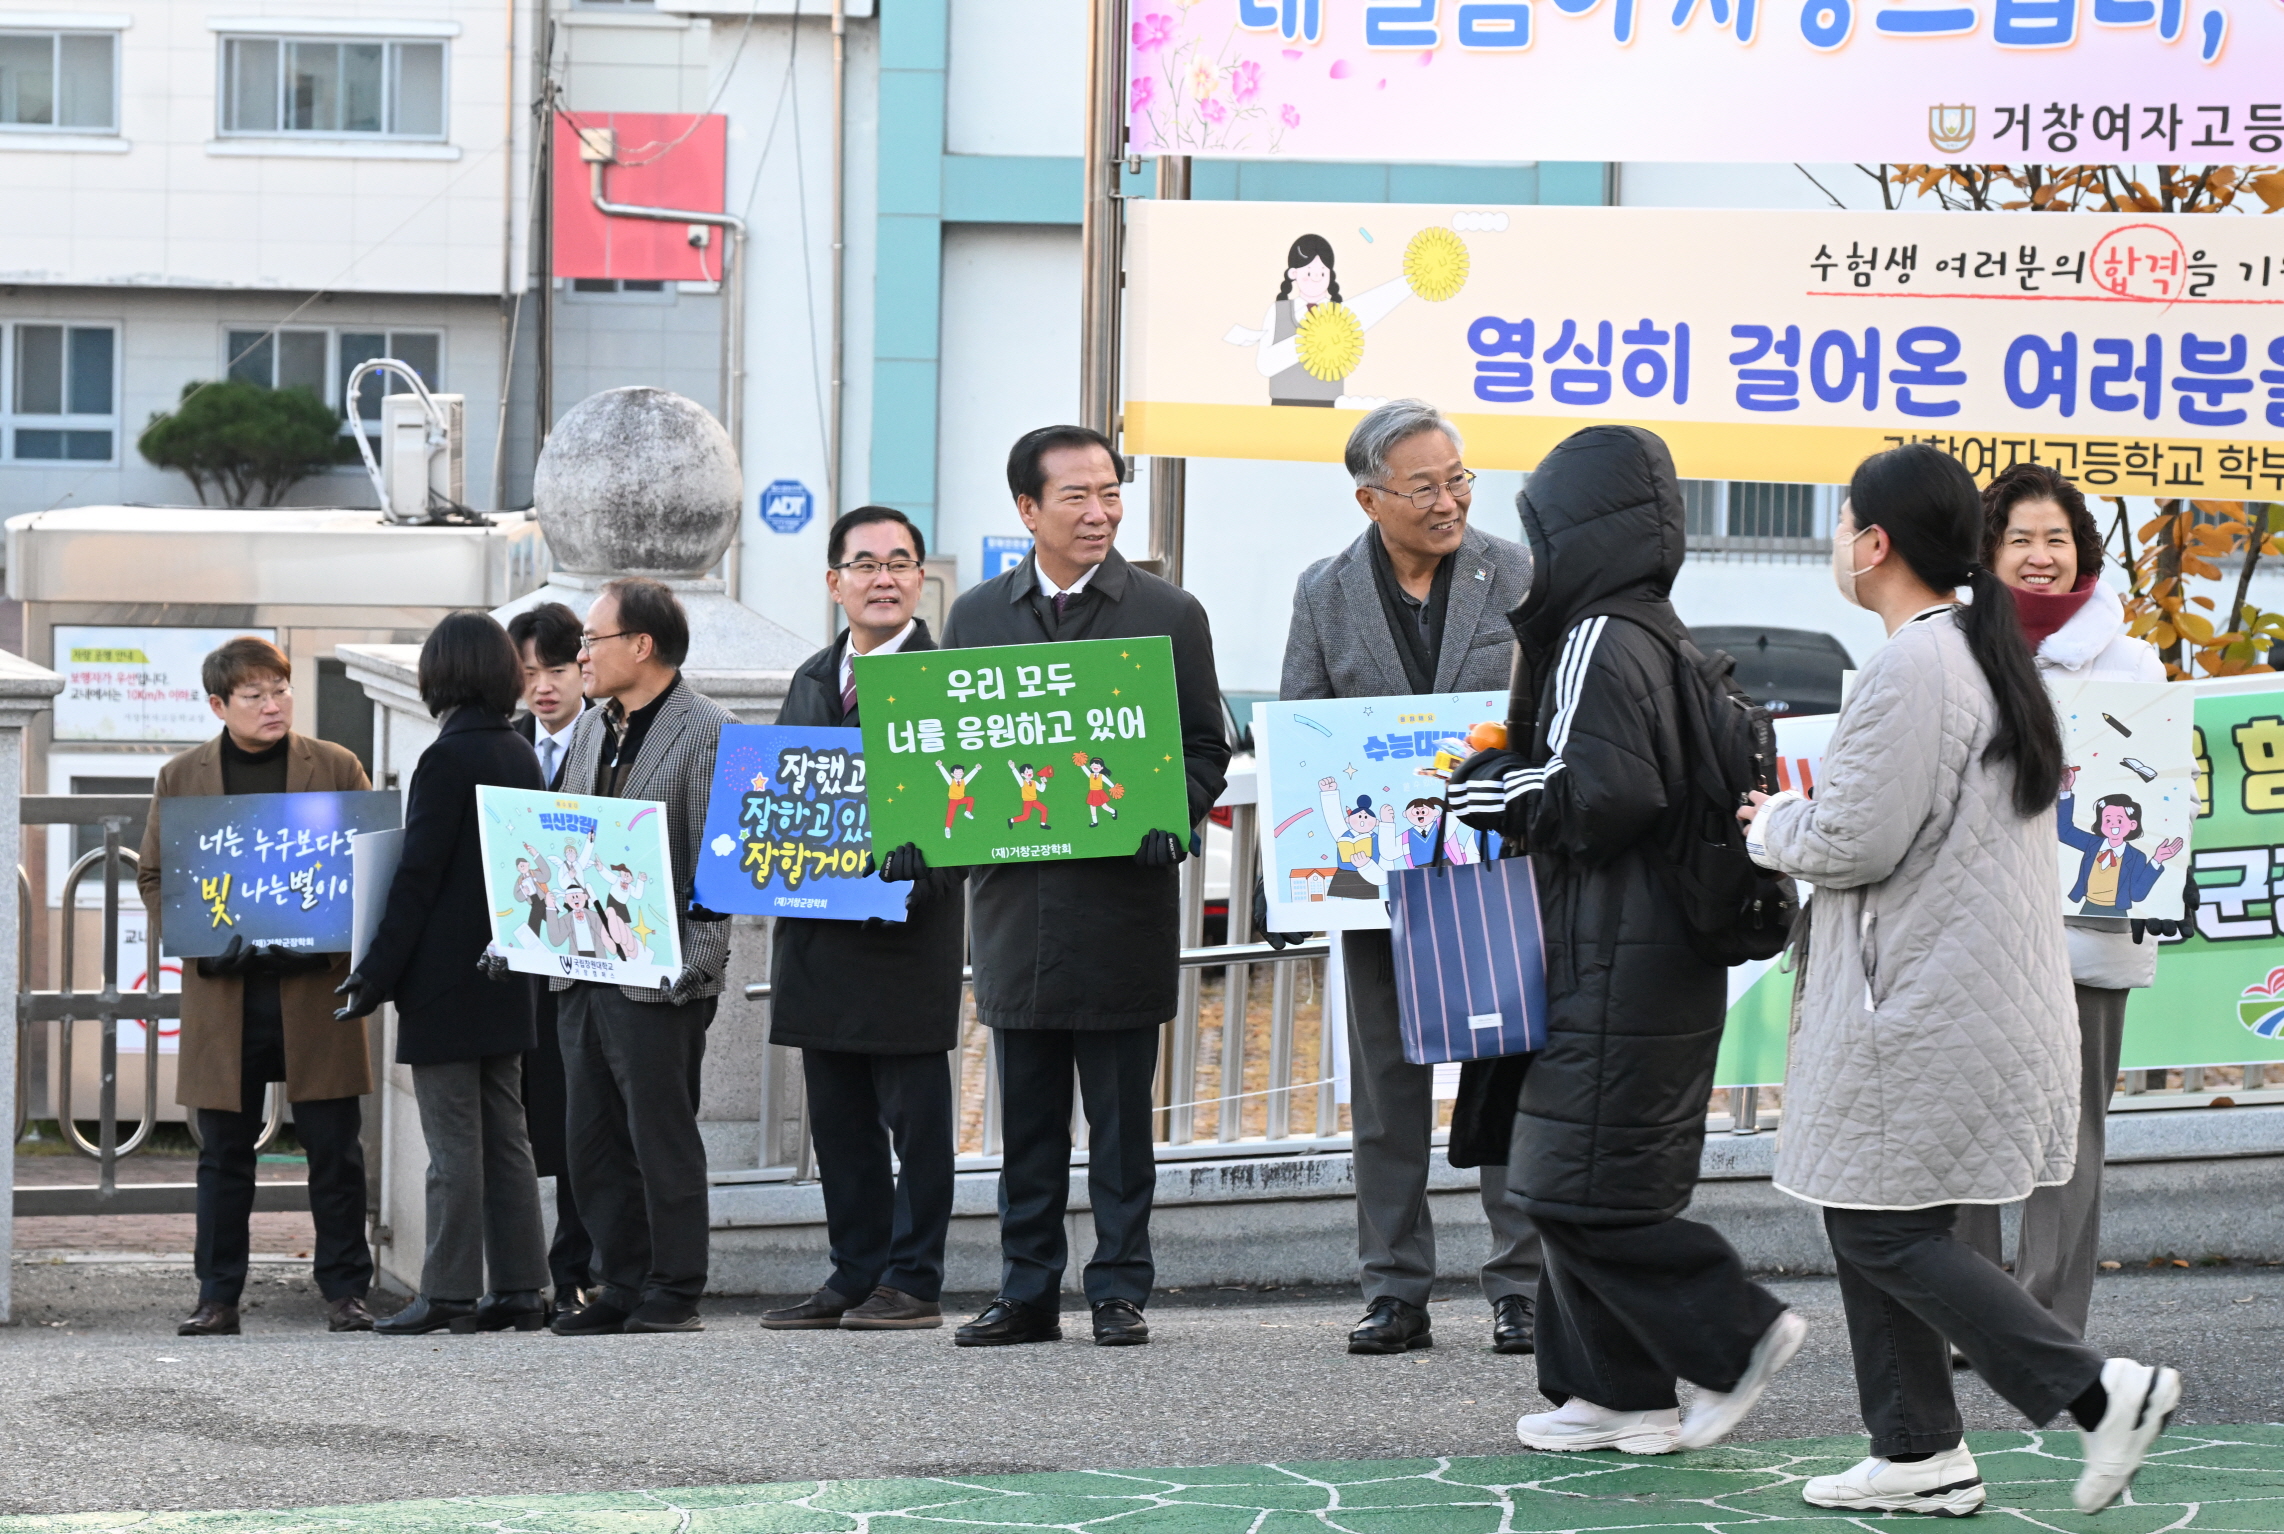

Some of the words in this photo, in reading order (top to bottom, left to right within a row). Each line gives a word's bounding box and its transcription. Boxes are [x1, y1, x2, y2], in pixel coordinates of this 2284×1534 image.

[1810, 241, 1918, 288] 수험생
[1935, 245, 2086, 291] 여러분의
[2238, 255, 2284, 287] 기
[1466, 314, 1690, 406] 열심히
[1729, 323, 1968, 418] 걸어온
[767, 496, 806, 517] ADT
[115, 649, 134, 662] 안내
[70, 671, 112, 685] 보행자가
[70, 688, 122, 702] 교내에서는
[168, 688, 200, 702] 이하로
[947, 666, 1006, 703] 우리
[1016, 663, 1076, 698] 모두
[887, 718, 946, 754] 너를
[956, 710, 1077, 751] 응원하고
[1086, 705, 1146, 742] 있어
[781, 753, 866, 795] 잘했고
[744, 796, 831, 838] 잘하고
[841, 804, 872, 843] 있
[199, 825, 244, 858] 너는
[991, 842, 1072, 860] (재)거창군장학회
[201, 873, 233, 928] 빛
